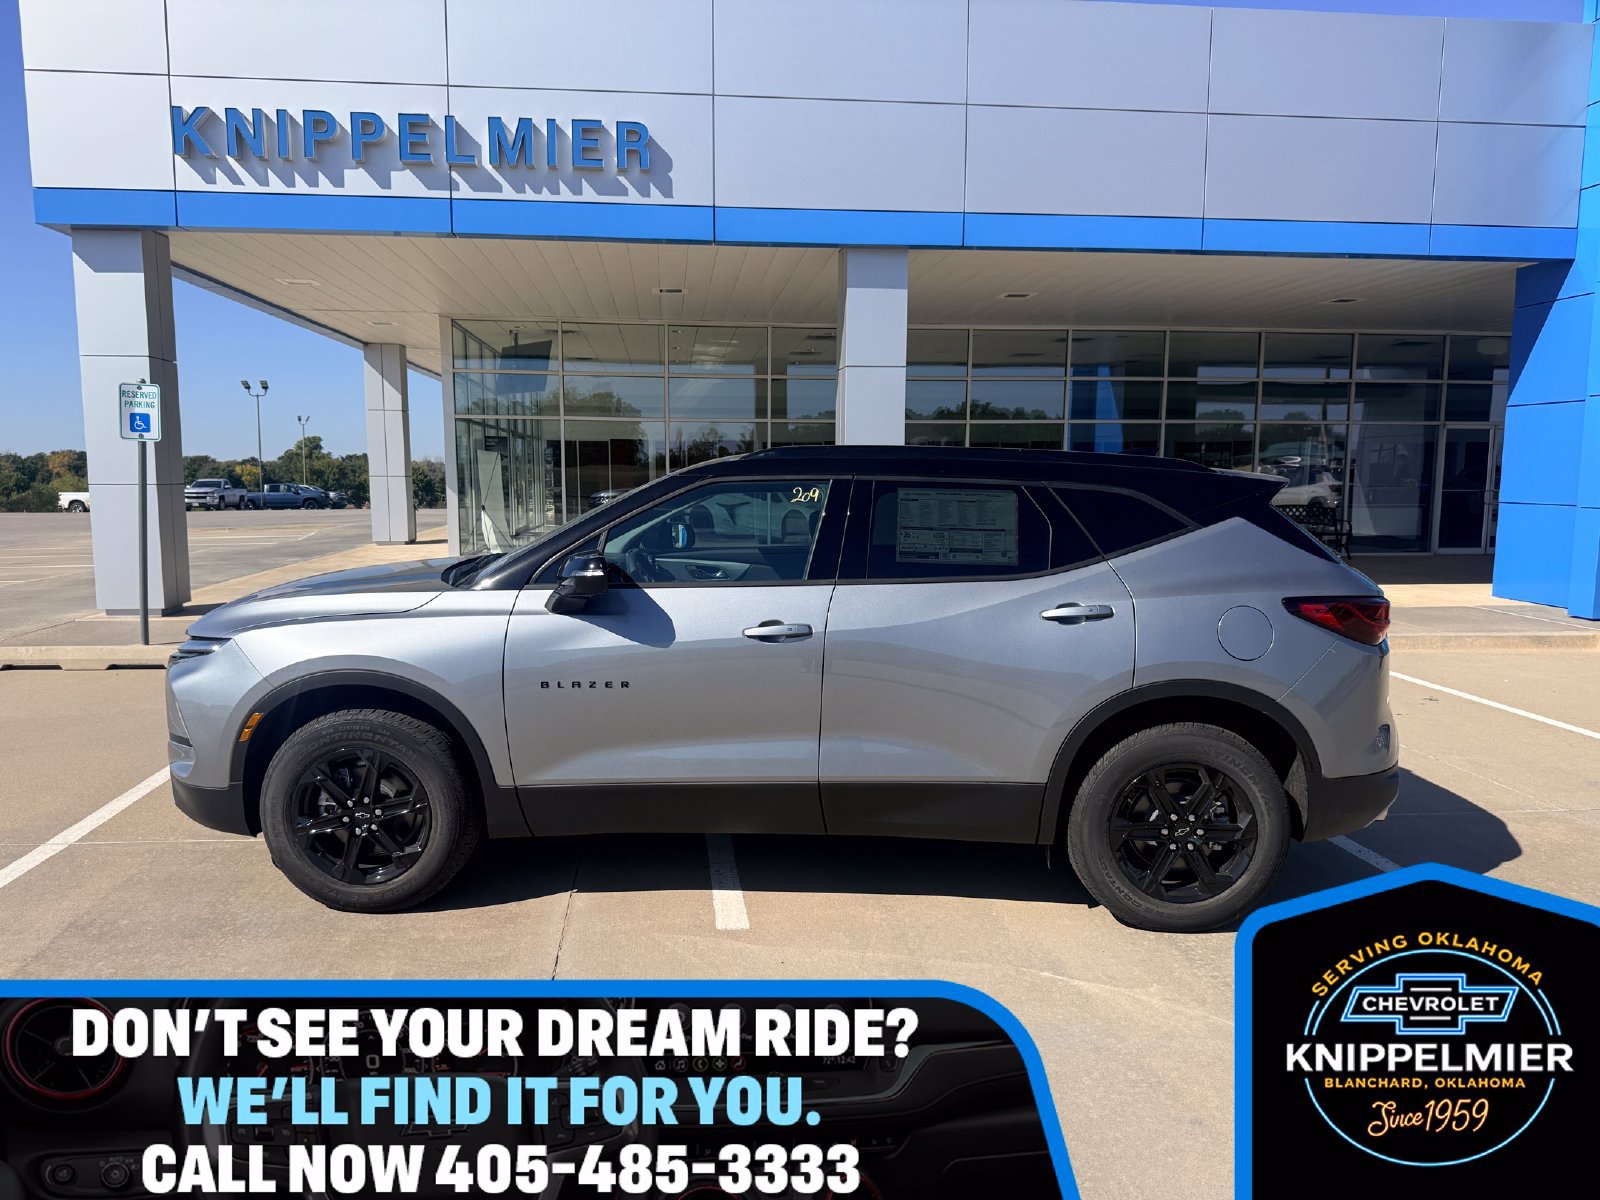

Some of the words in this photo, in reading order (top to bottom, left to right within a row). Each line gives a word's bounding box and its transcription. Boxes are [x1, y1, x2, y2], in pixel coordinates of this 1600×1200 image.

[171, 106, 651, 170] KNIPPELMIER
[122, 390, 156, 400] RESERVED
[124, 400, 155, 409] PARKING
[790, 486, 820, 503] 209
[540, 680, 632, 689] BLAZER
